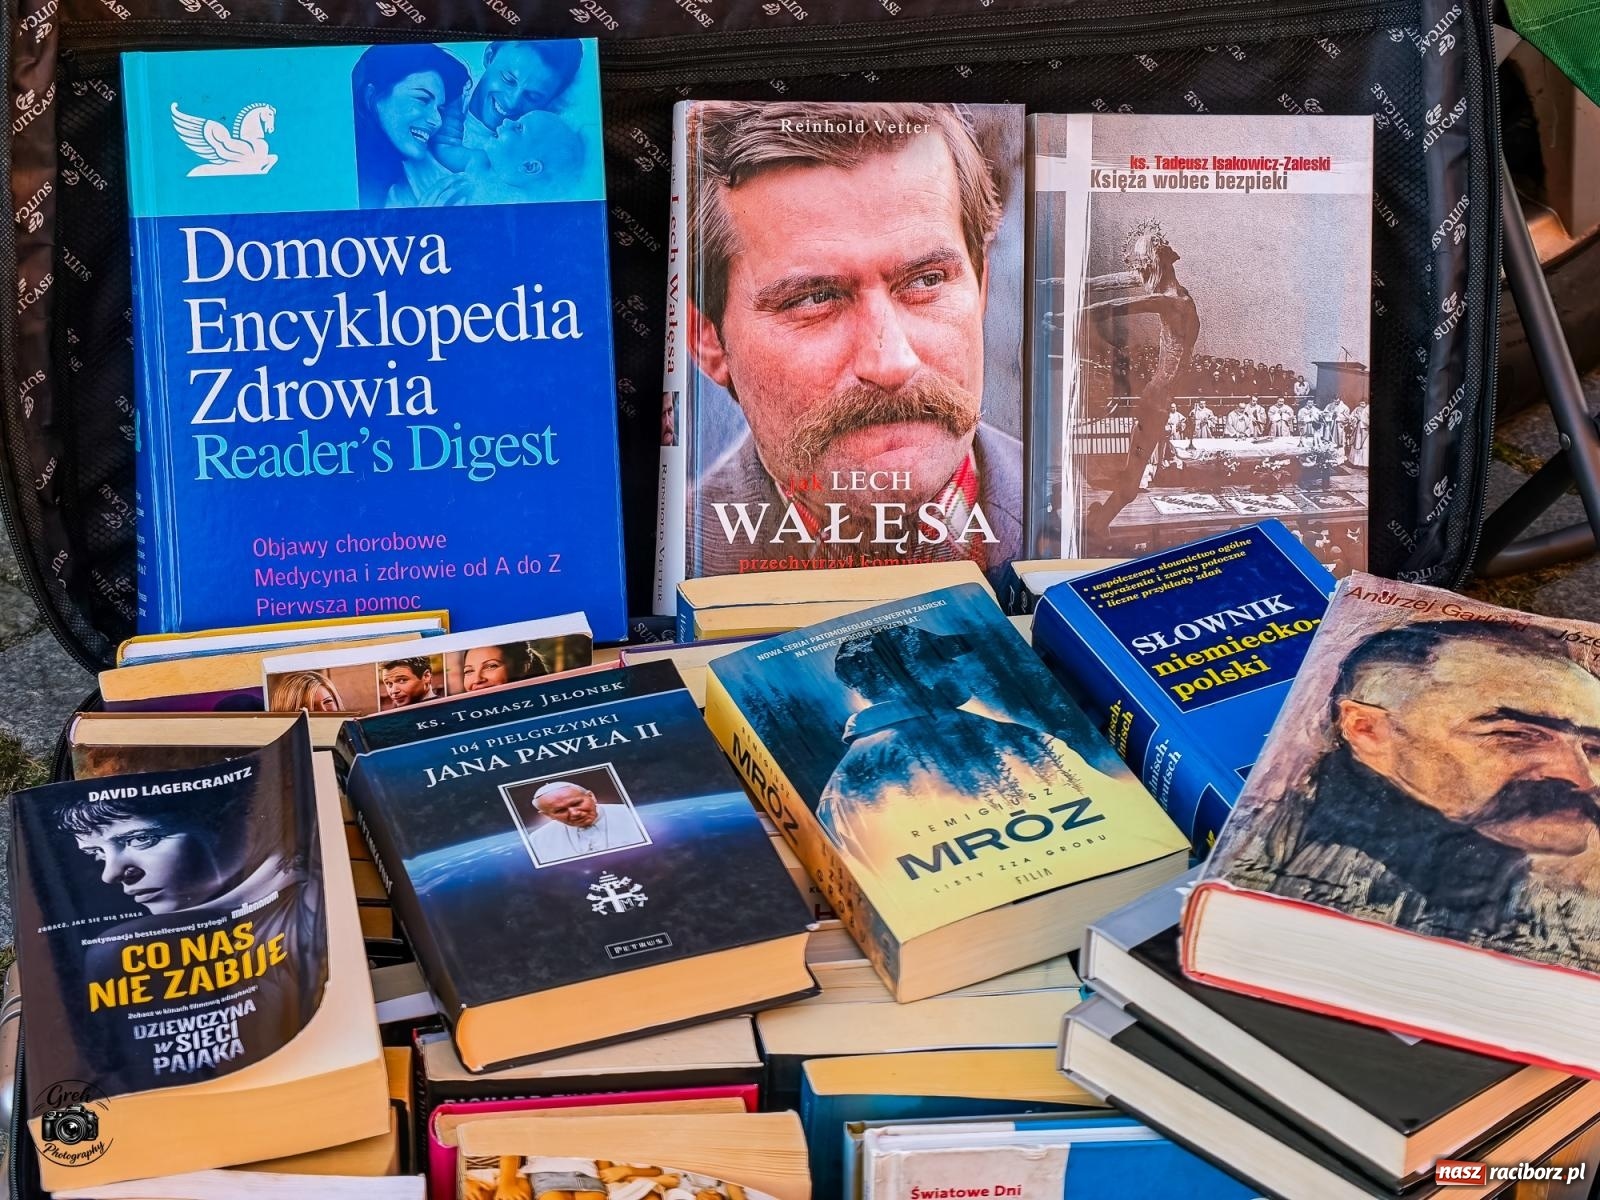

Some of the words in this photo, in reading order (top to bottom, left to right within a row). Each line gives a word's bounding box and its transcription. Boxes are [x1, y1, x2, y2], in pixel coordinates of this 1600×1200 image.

[781, 119, 865, 135] Reinhold
[873, 120, 931, 135] Vetter
[1090, 170, 1147, 193] Księża
[1153, 171, 1209, 190] wobec
[1215, 171, 1288, 193] bezpieki
[1130, 155, 1150, 170] ks.
[1155, 155, 1208, 170] Tadeusz
[1212, 156, 1331, 171] Isakowicz-Zaleski
[179, 227, 452, 284] Domowa
[183, 284, 584, 367] Encyklopedia
[188, 361, 438, 425] Zdrowia
[193, 427, 394, 481] Reader's
[407, 422, 560, 482] Digest
[787, 470, 824, 493] jak
[831, 470, 913, 491] LECH
[253, 536, 329, 560] Objawy
[335, 533, 448, 554] chorobowe
[711, 502, 1001, 554] WAŁĘSA
[255, 566, 358, 590] Medycyna
[364, 564, 370, 582] i
[377, 560, 457, 581] zdrowie
[463, 557, 488, 577] od
[495, 556, 511, 576] A
[517, 555, 542, 574] do
[549, 554, 561, 573] Z
[1092, 566, 1156, 592] współczesne
[1158, 549, 1216, 573] słownictwo
[1218, 537, 1253, 555] ogólne
[1099, 577, 1155, 600] wyrażenia
[1155, 573, 1163, 583] i
[1164, 563, 1200, 582] zwroty
[1201, 550, 1247, 573] potoczne
[256, 595, 348, 617] Pierwsza
[354, 593, 422, 615] pomoc
[1106, 592, 1140, 608] liczne
[1141, 576, 1194, 602] przykłady
[1195, 568, 1223, 584] zdań
[1344, 586, 1436, 613] Andrzej
[757, 648, 784, 662] NOWA
[784, 637, 811, 654] SERIA!
[810, 618, 873, 643] PATOMORFOLOG
[873, 608, 913, 624] SEWERYN
[913, 599, 947, 614] ZAORSKI
[795, 649, 808, 659] NA
[808, 638, 837, 656] TROPIE
[837, 628, 872, 645] ZBRODNI
[871, 620, 904, 637] SPRZED
[903, 615, 922, 627] LAT.
[1131, 594, 1295, 656] SŁOWNIK
[1152, 617, 1322, 678] niemiecko-
[1171, 654, 1272, 703] polski
[423, 754, 509, 788] JANA
[515, 728, 632, 766] PAWŁA
[635, 721, 664, 740] II
[450, 741, 480, 757] 104
[486, 713, 621, 748] PIELGRZYMKI
[88, 786, 138, 803] DAVID
[141, 766, 253, 797] LAGERCRANTZ
[911, 788, 1054, 838] REMIGIUSZ
[896, 796, 1106, 881] MRÓZ
[934, 871, 985, 894] LISTY
[1000, 857, 1031, 871] ZZA
[1046, 834, 1107, 856] GROBU
[1014, 867, 1053, 885] FILIA
[81, 931, 134, 946] Kontynuacja
[134, 922, 196, 940] bestsellerowej
[196, 916, 228, 930] trylogii
[121, 942, 172, 973] CO
[180, 921, 256, 967] NAS
[613, 937, 664, 954] PETRUS
[88, 974, 154, 1013] NIE
[163, 932, 289, 1000] ZABIJE
[133, 998, 257, 1040] DZIEWCZYNA
[175, 1019, 239, 1053] SIECI
[910, 1184, 990, 1200] Światowe
[994, 1184, 1022, 1197] Dni
